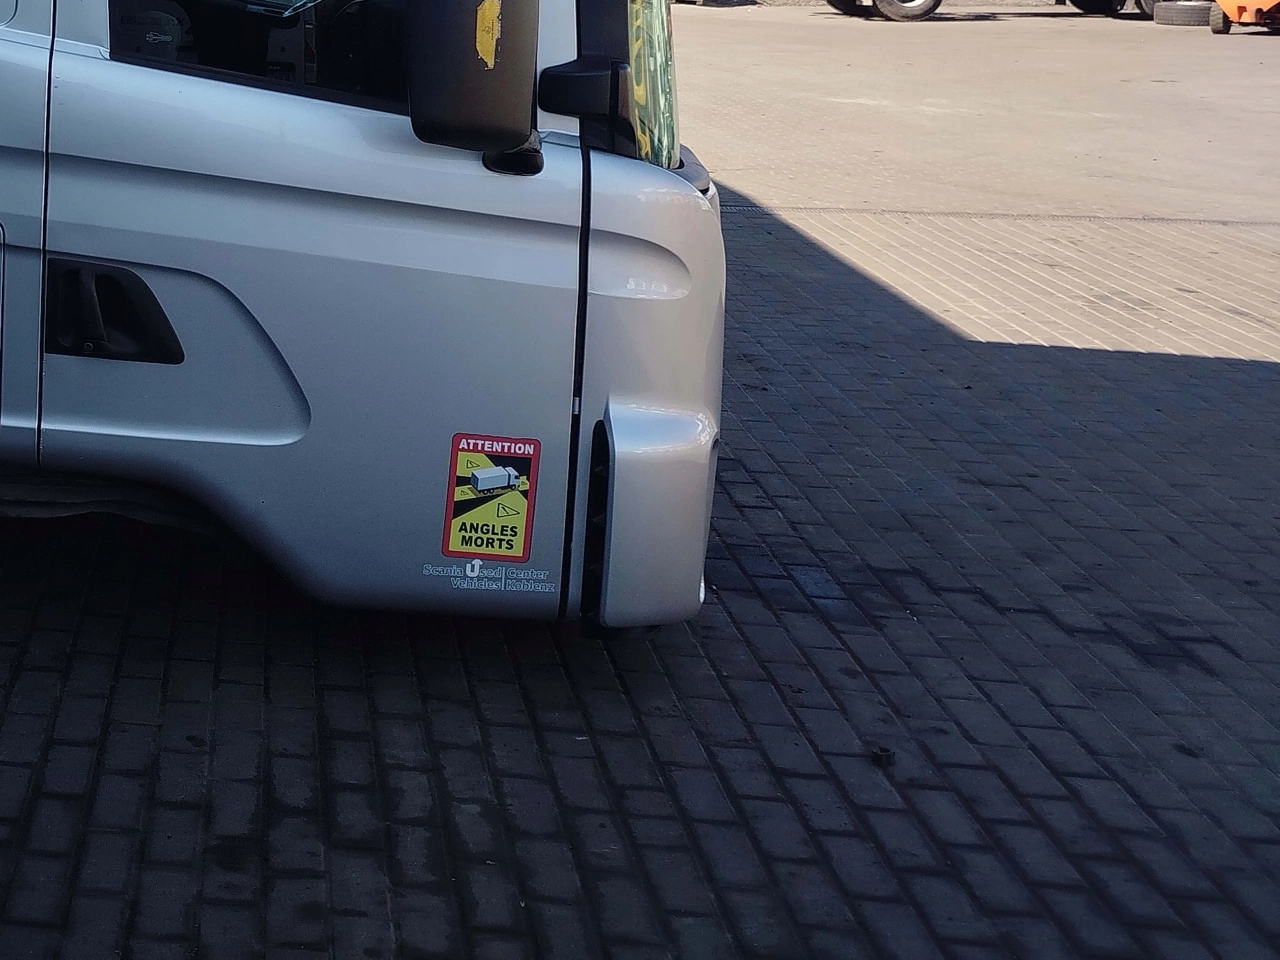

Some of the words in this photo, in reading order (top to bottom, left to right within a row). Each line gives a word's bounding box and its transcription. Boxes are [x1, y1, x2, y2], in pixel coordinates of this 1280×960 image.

[458, 438, 535, 455] ATTENTION
[458, 522, 518, 537] ANGLES
[460, 536, 514, 550] MORTS
[422, 564, 464, 576] Scania
[465, 559, 501, 578] Used
[506, 567, 550, 580] Center
[451, 577, 501, 590] Vehicles
[506, 579, 555, 592] Koblenz
